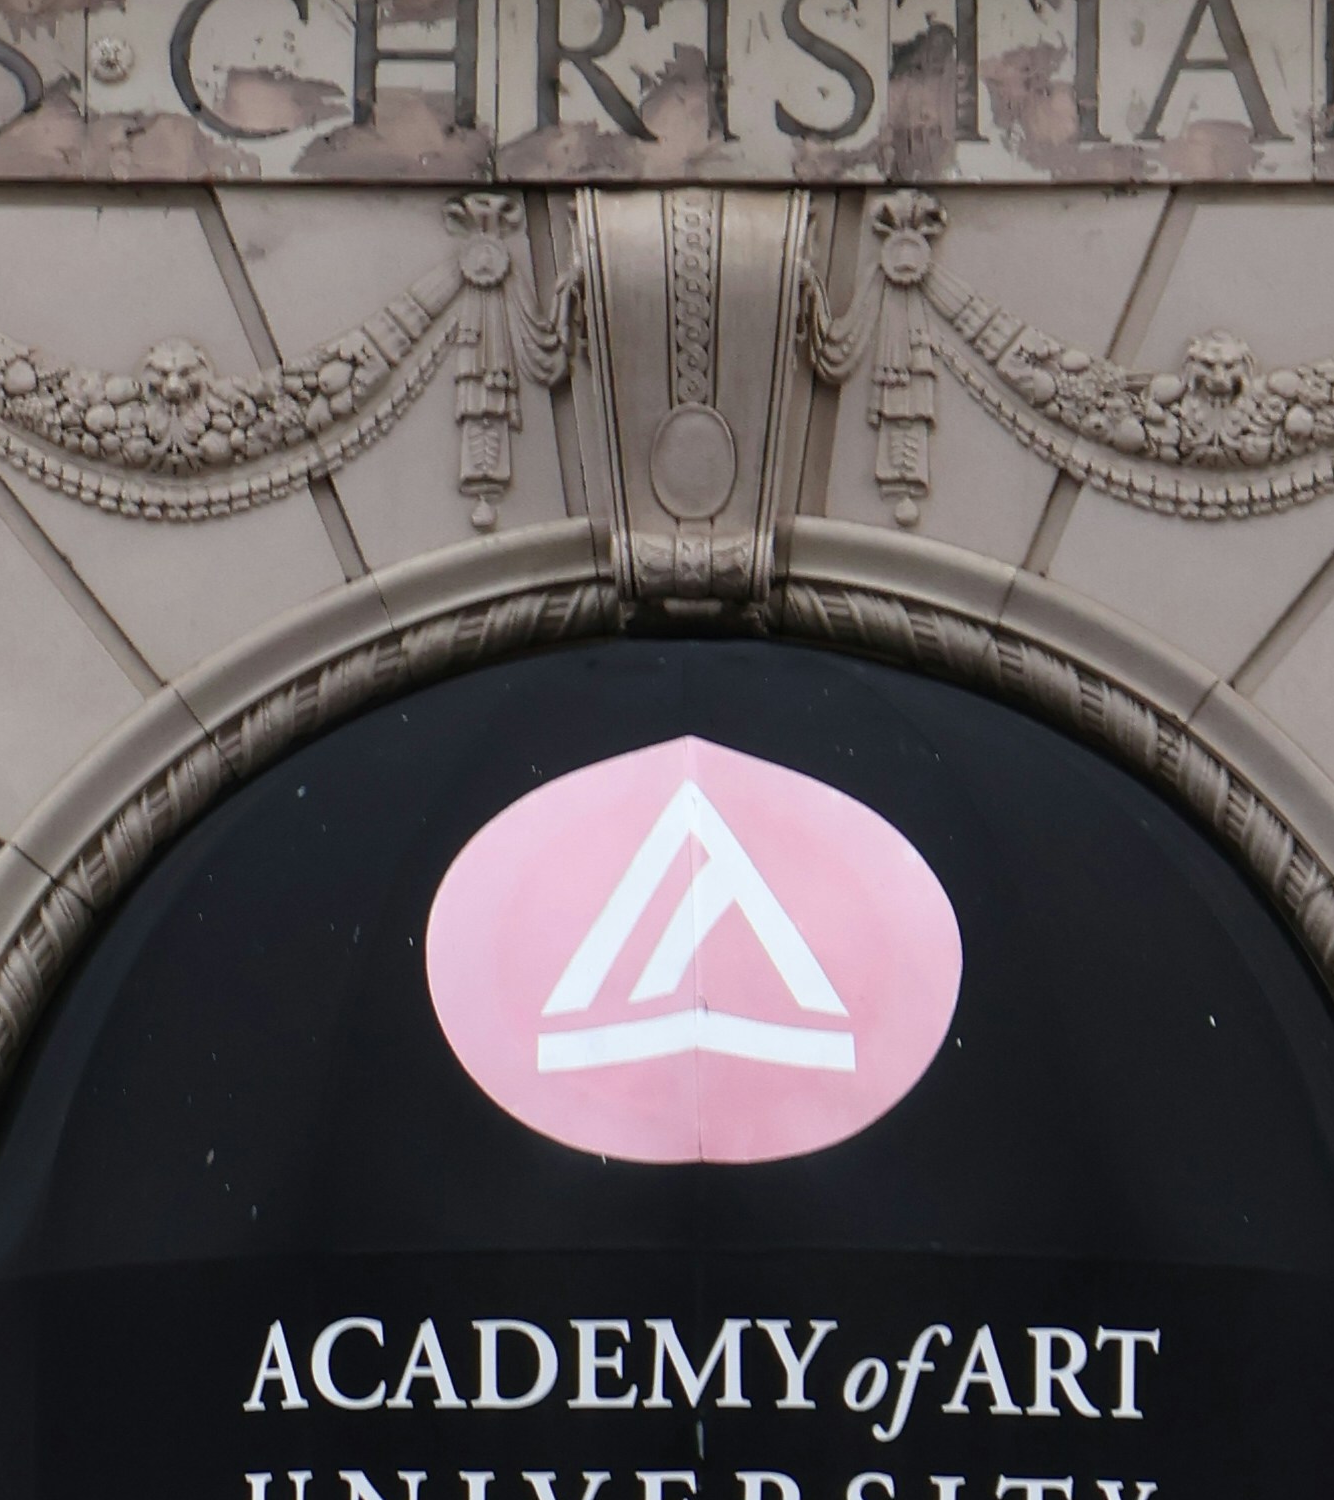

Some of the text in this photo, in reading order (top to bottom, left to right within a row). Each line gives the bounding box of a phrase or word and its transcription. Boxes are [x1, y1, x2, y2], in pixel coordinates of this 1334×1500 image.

[242, 1316, 1161, 1443] ACADEMY of ART
